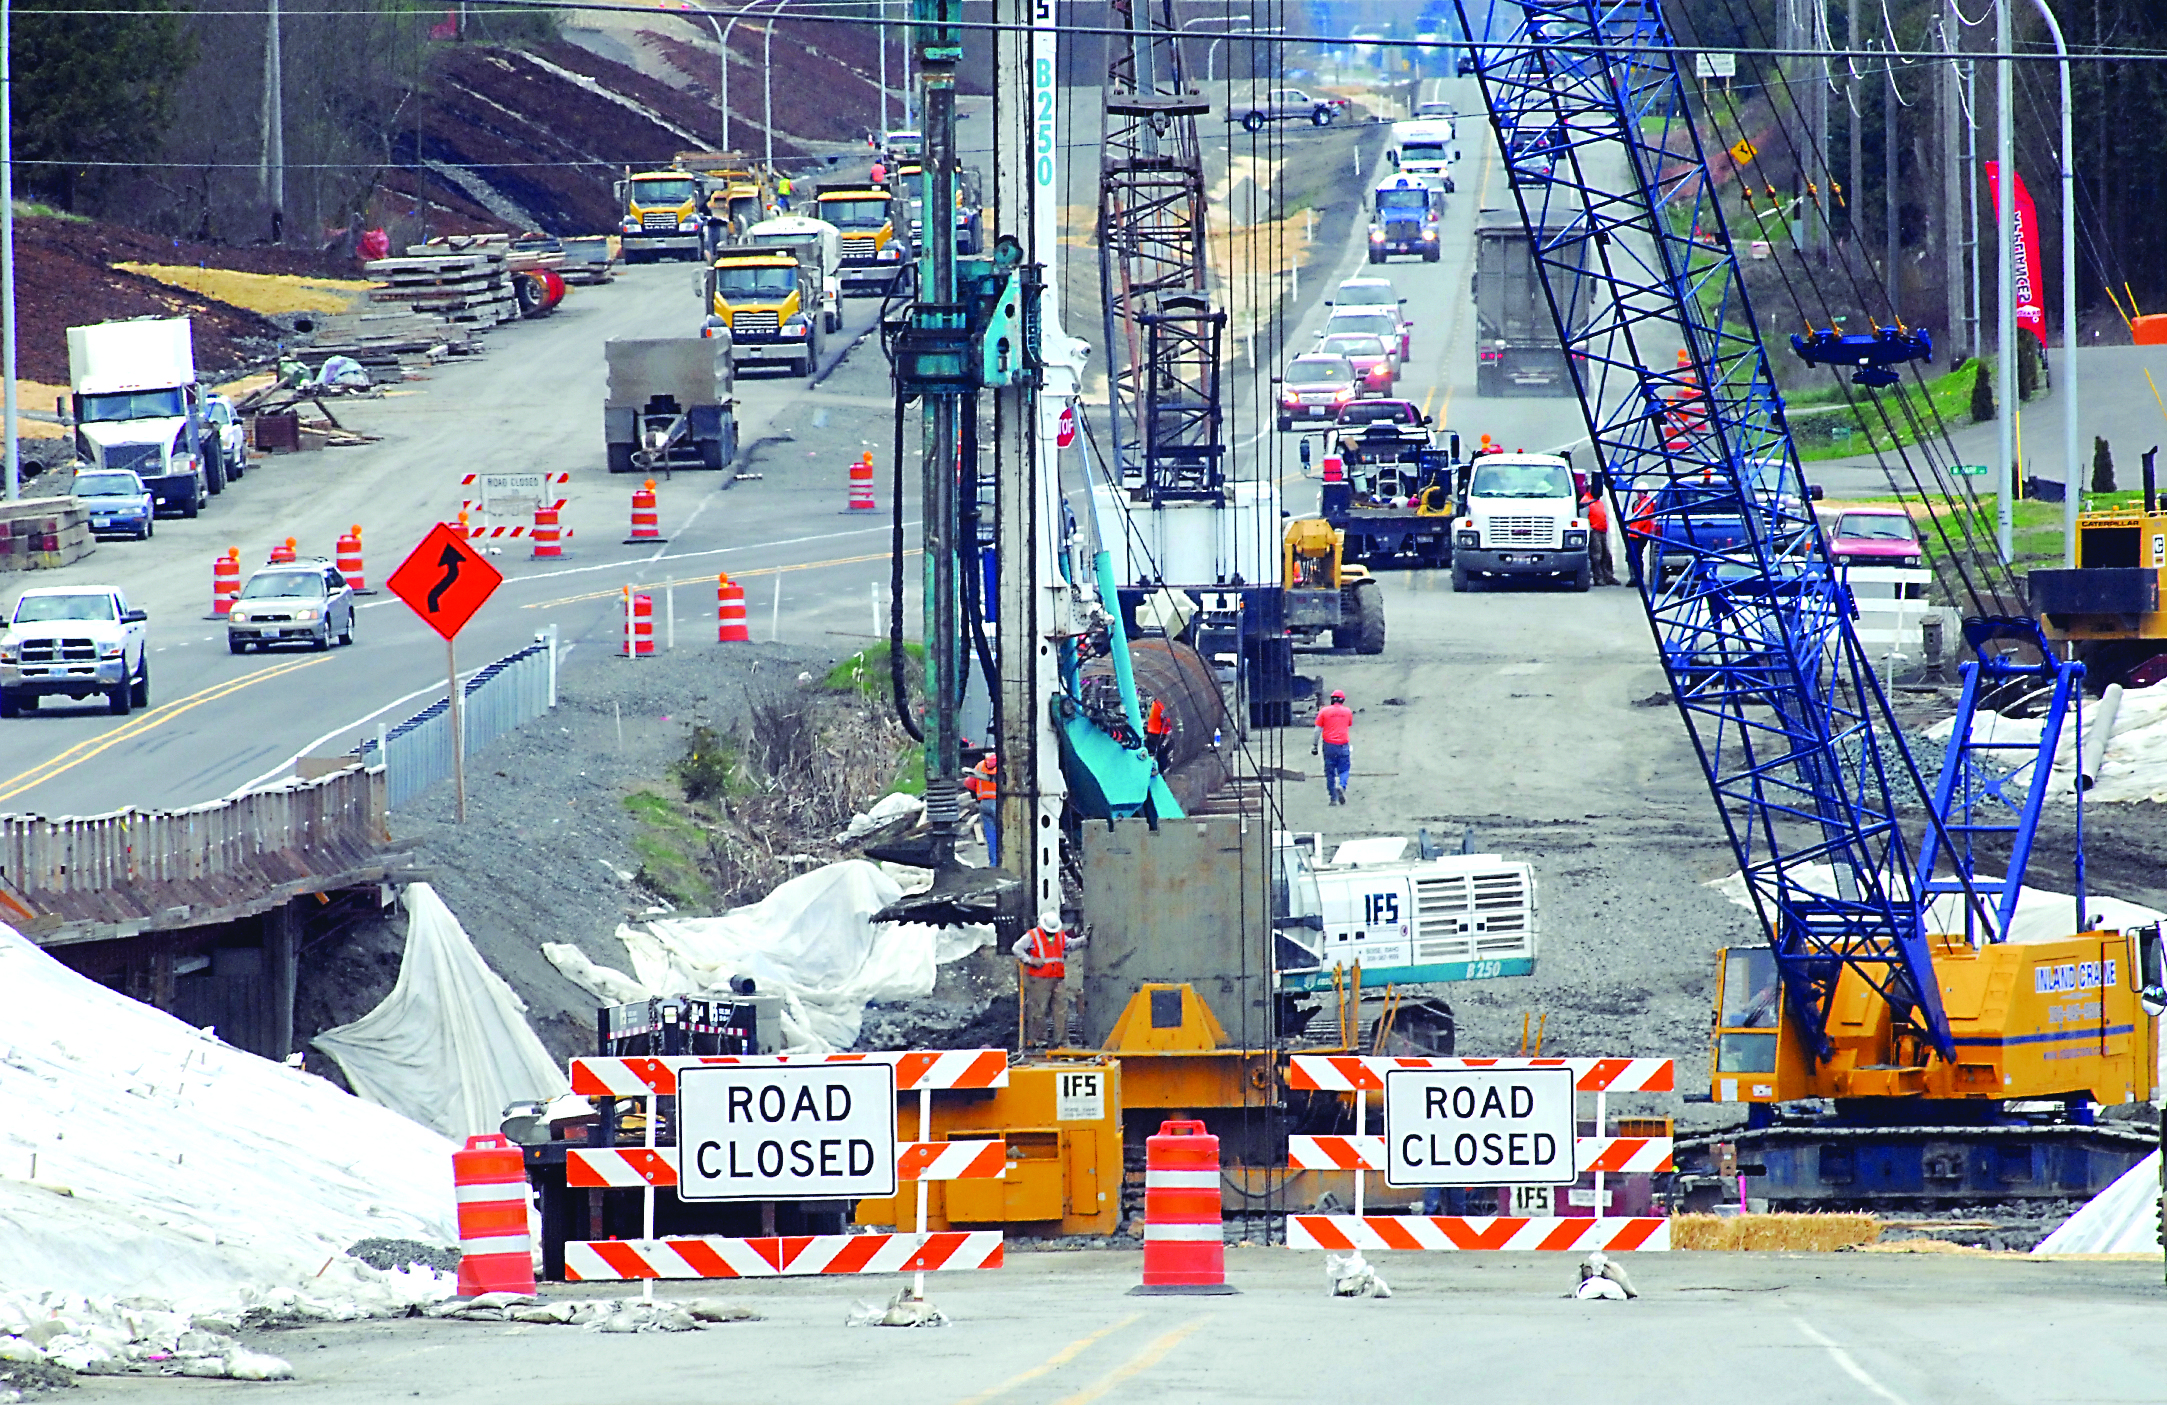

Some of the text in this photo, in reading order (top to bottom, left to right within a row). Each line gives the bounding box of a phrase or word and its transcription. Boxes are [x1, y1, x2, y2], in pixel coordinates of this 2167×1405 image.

[1036, 58, 1053, 186] B250
[487, 477, 539, 487] ROAD CLOSED
[1365, 893, 1398, 925] IFS
[2035, 964, 2076, 993] INLAND
[1064, 1076, 1096, 1097] IFS
[1426, 1085, 1534, 1119] ROAD
[728, 1085, 852, 1123] ROAD
[697, 1139, 875, 1178] CLOSED
[1402, 1133, 1556, 1167] CLOSED
[1517, 1186, 1548, 1209] IFS
